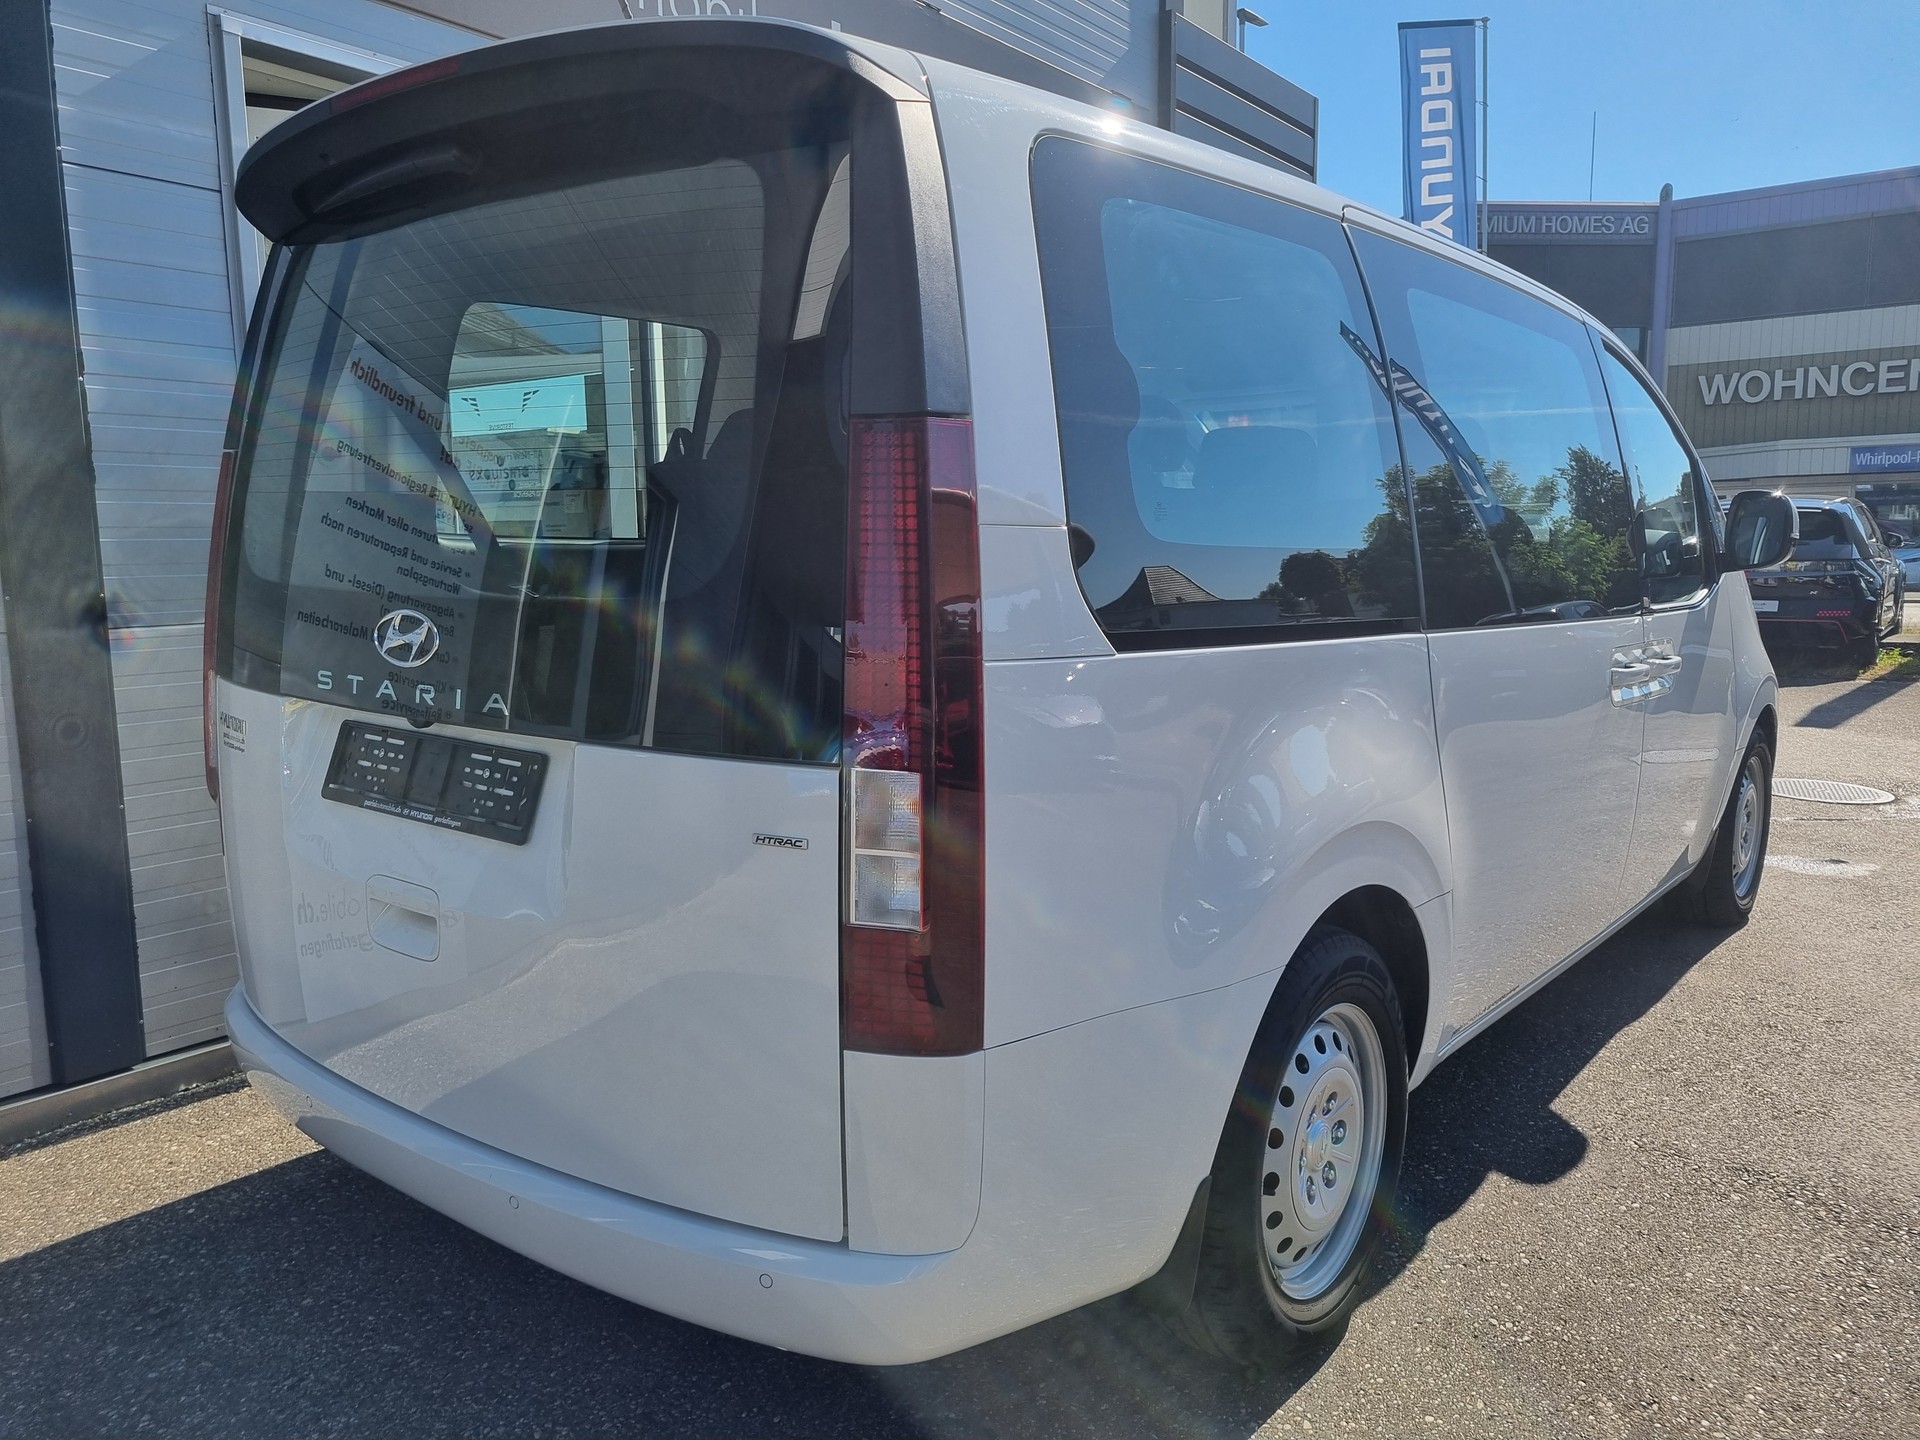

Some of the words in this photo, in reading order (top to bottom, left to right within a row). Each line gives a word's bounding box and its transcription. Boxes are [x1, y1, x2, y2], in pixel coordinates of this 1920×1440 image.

[1541, 215, 1615, 234] HOMES
[1620, 215, 1649, 234] AG
[317, 669, 510, 716] STARIA
[755, 835, 803, 848] HTRAC
